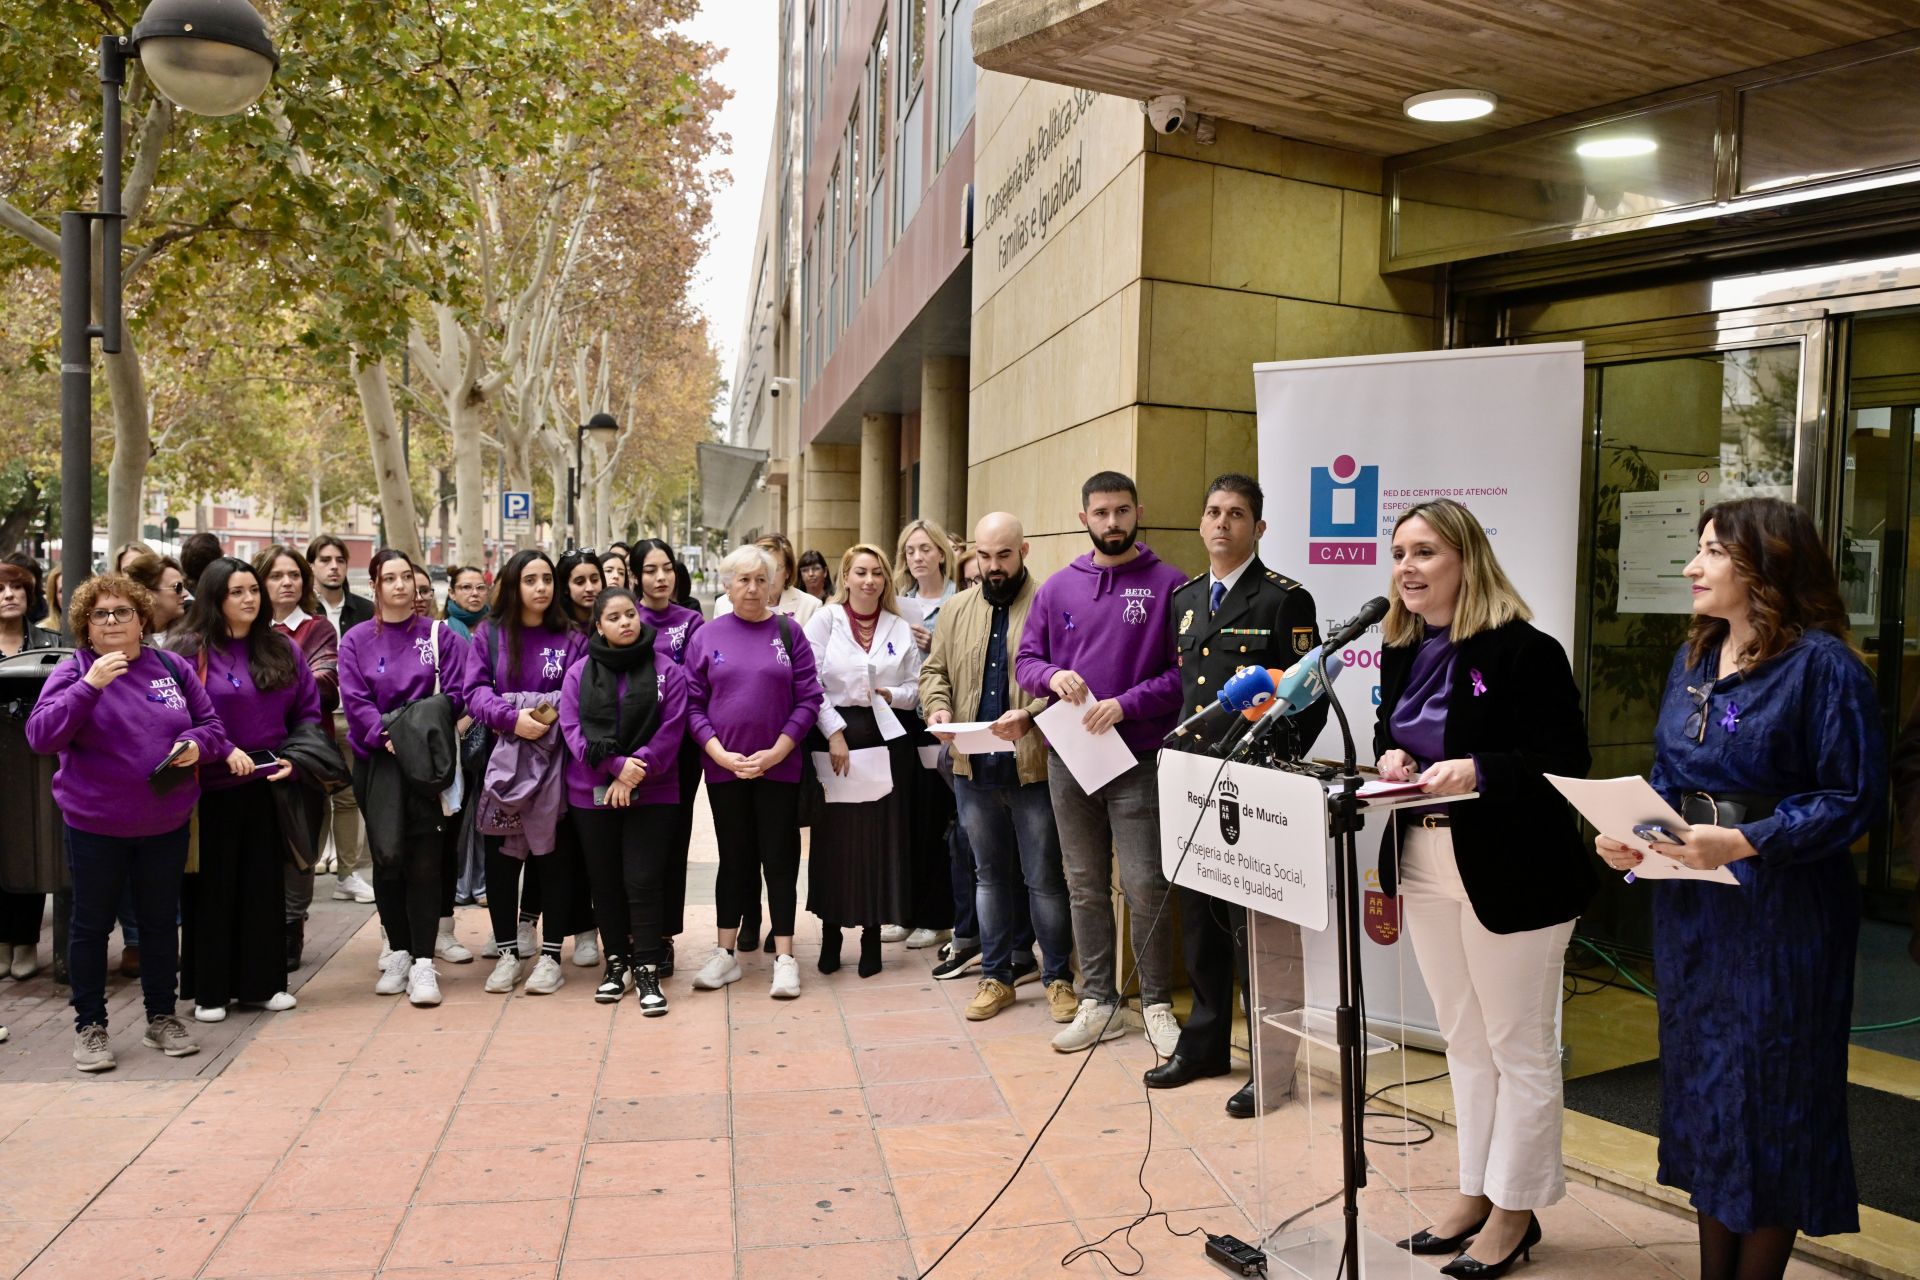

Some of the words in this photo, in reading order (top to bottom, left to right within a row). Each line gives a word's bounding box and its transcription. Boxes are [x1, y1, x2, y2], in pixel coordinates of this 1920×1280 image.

[985, 155, 1022, 231] Consejería
[1024, 138, 1036, 183] de
[1037, 98, 1072, 169] Política
[998, 213, 1029, 273] Familias
[1030, 207, 1038, 238] e
[1039, 140, 1083, 240] Igualdad
[1383, 489, 1399, 497] RED
[1400, 489, 1411, 497] DE
[1412, 488, 1452, 497] CENTROS
[1453, 488, 1464, 496] DE
[1465, 486, 1508, 496] ATENCIÓN
[508, 495, 525, 517] P
[1320, 547, 1365, 560] CAVI
[1125, 588, 1152, 597] BETO
[1242, 804, 1254, 818] de
[1256, 807, 1288, 827] Murcia
[1223, 849, 1236, 866] de
[1238, 853, 1271, 876] Política
[1274, 863, 1306, 888] Social,
[1197, 862, 1232, 886] Familias
[1233, 876, 1240, 888] e
[1242, 876, 1283, 902] Igualdad
